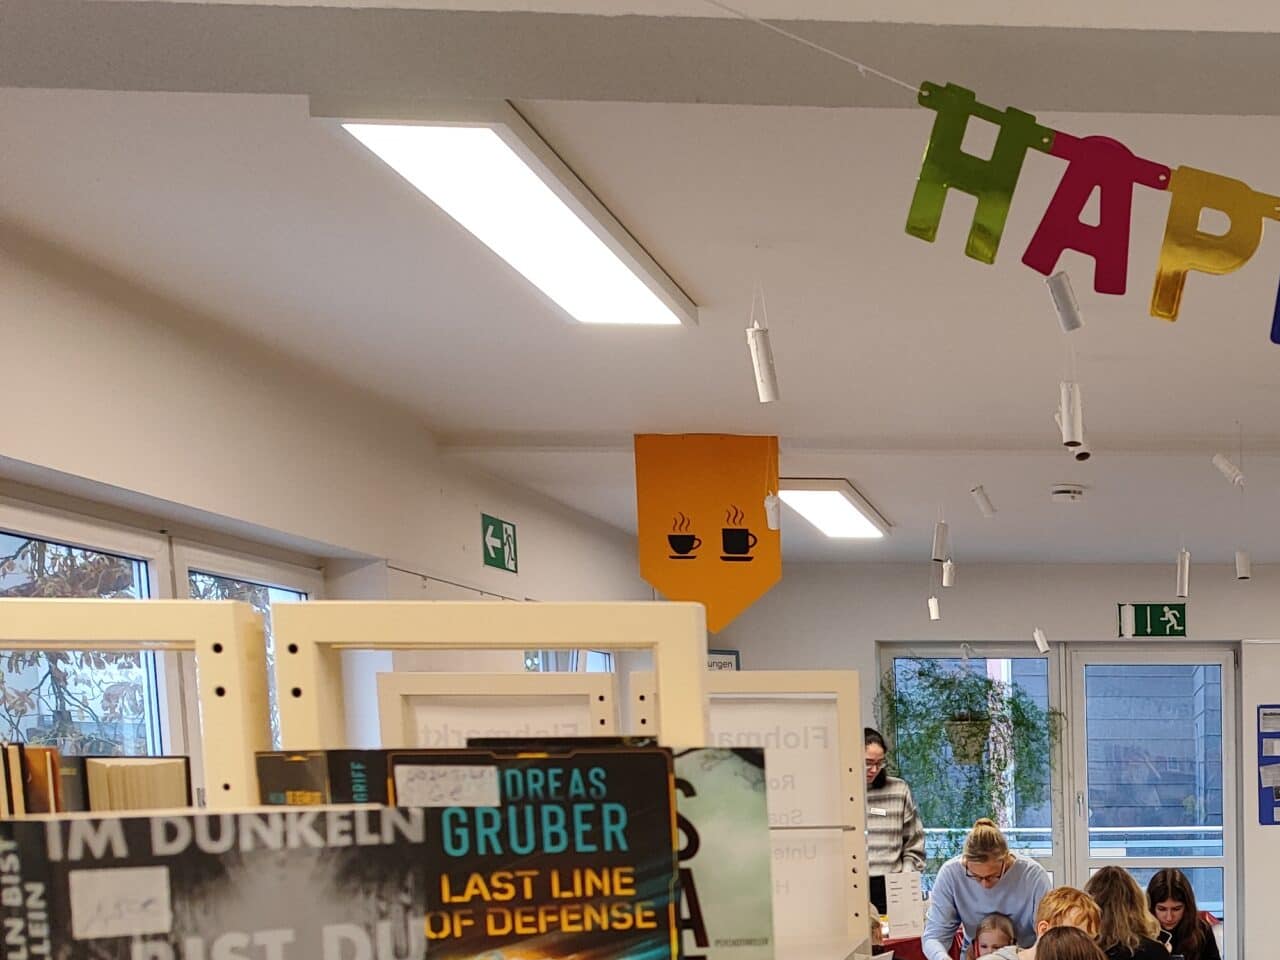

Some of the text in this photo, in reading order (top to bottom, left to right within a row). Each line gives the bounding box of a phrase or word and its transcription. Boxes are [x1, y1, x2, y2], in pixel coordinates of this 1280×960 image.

[707, 659, 733, 671] ungen
[496, 767, 607, 802] DREAS
[44, 805, 425, 862] IM DUNKELN
[441, 802, 630, 857] GRUBER
[441, 866, 637, 905] LAST LINE
[426, 902, 659, 941] OF DEFENSE
